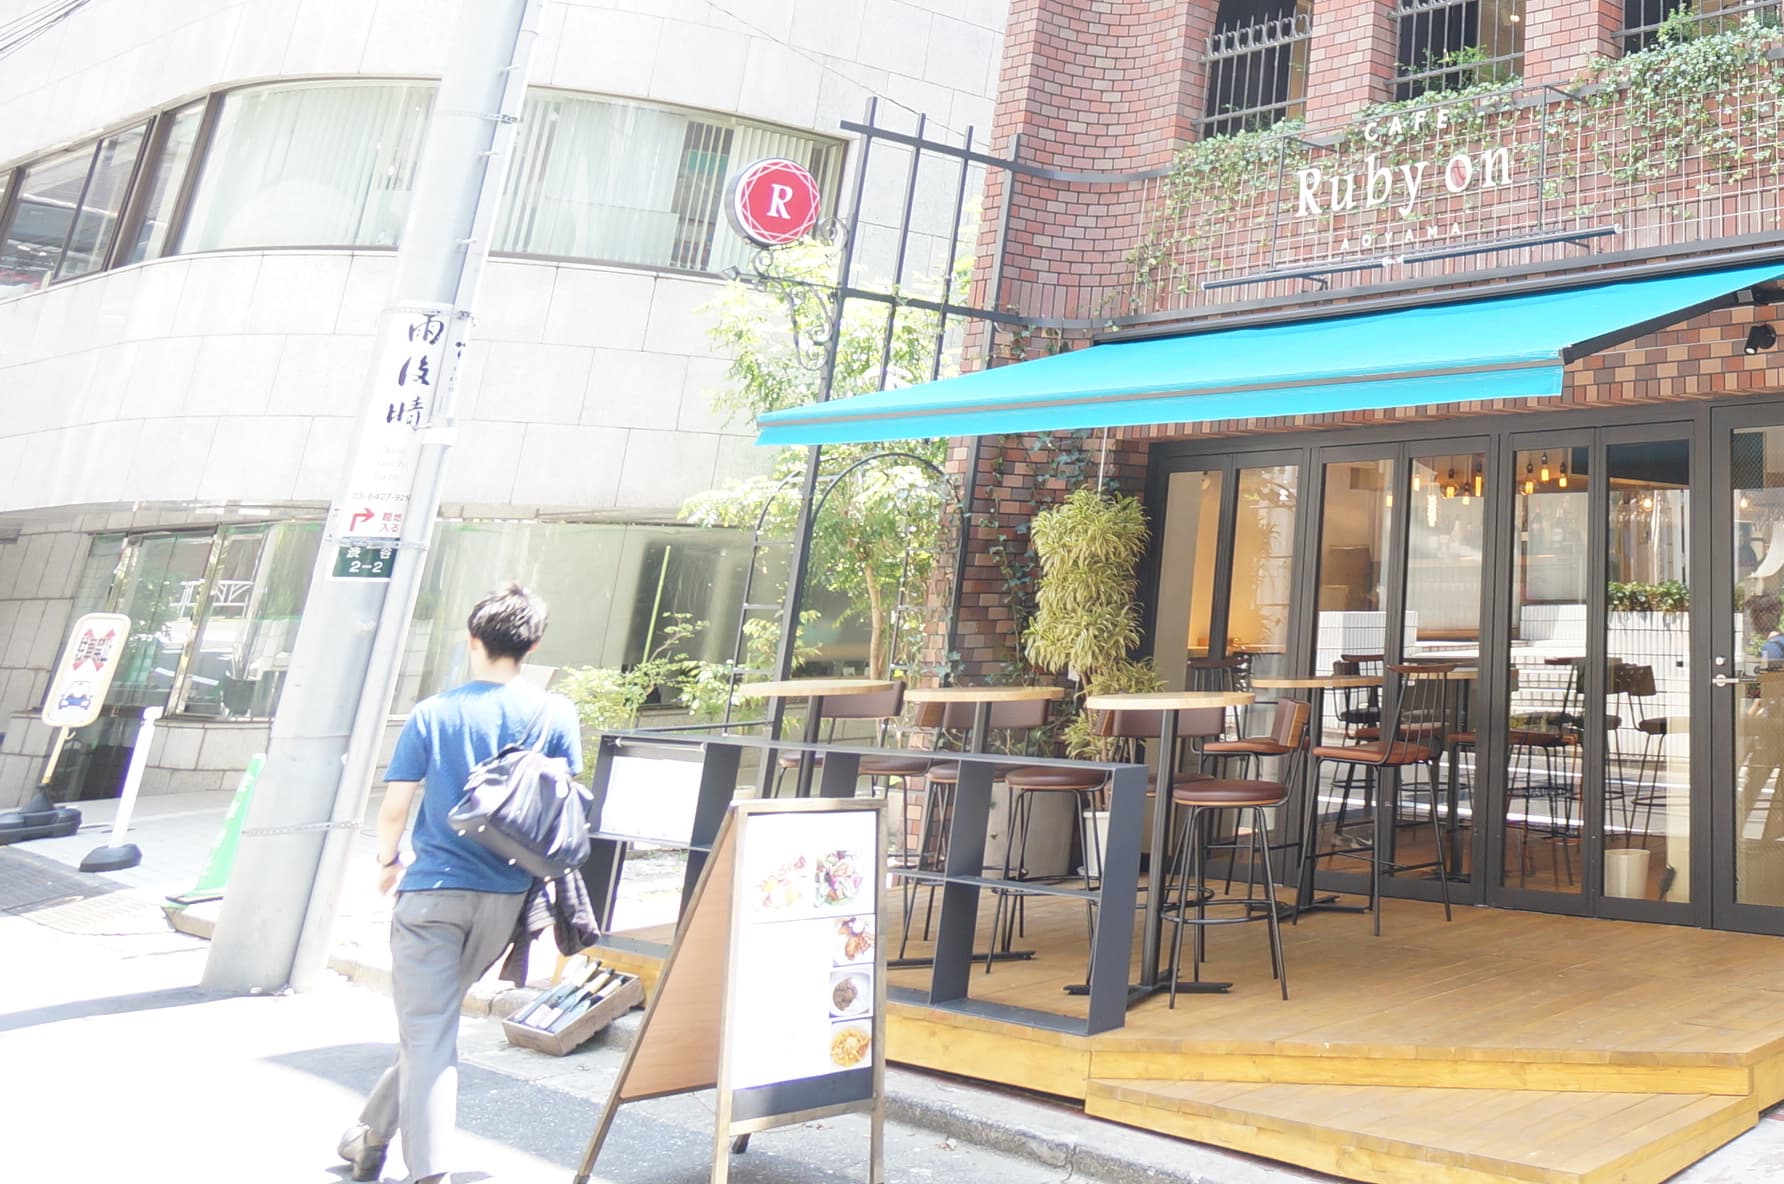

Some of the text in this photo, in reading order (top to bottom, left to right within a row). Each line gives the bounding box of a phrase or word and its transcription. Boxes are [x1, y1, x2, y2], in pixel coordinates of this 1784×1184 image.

[1364, 109, 1450, 142] CAFE
[1295, 146, 1513, 217] Ruby on
[766, 183, 793, 220] R
[1340, 222, 1461, 251] AOYAMA
[349, 560, 383, 573] 2-2
